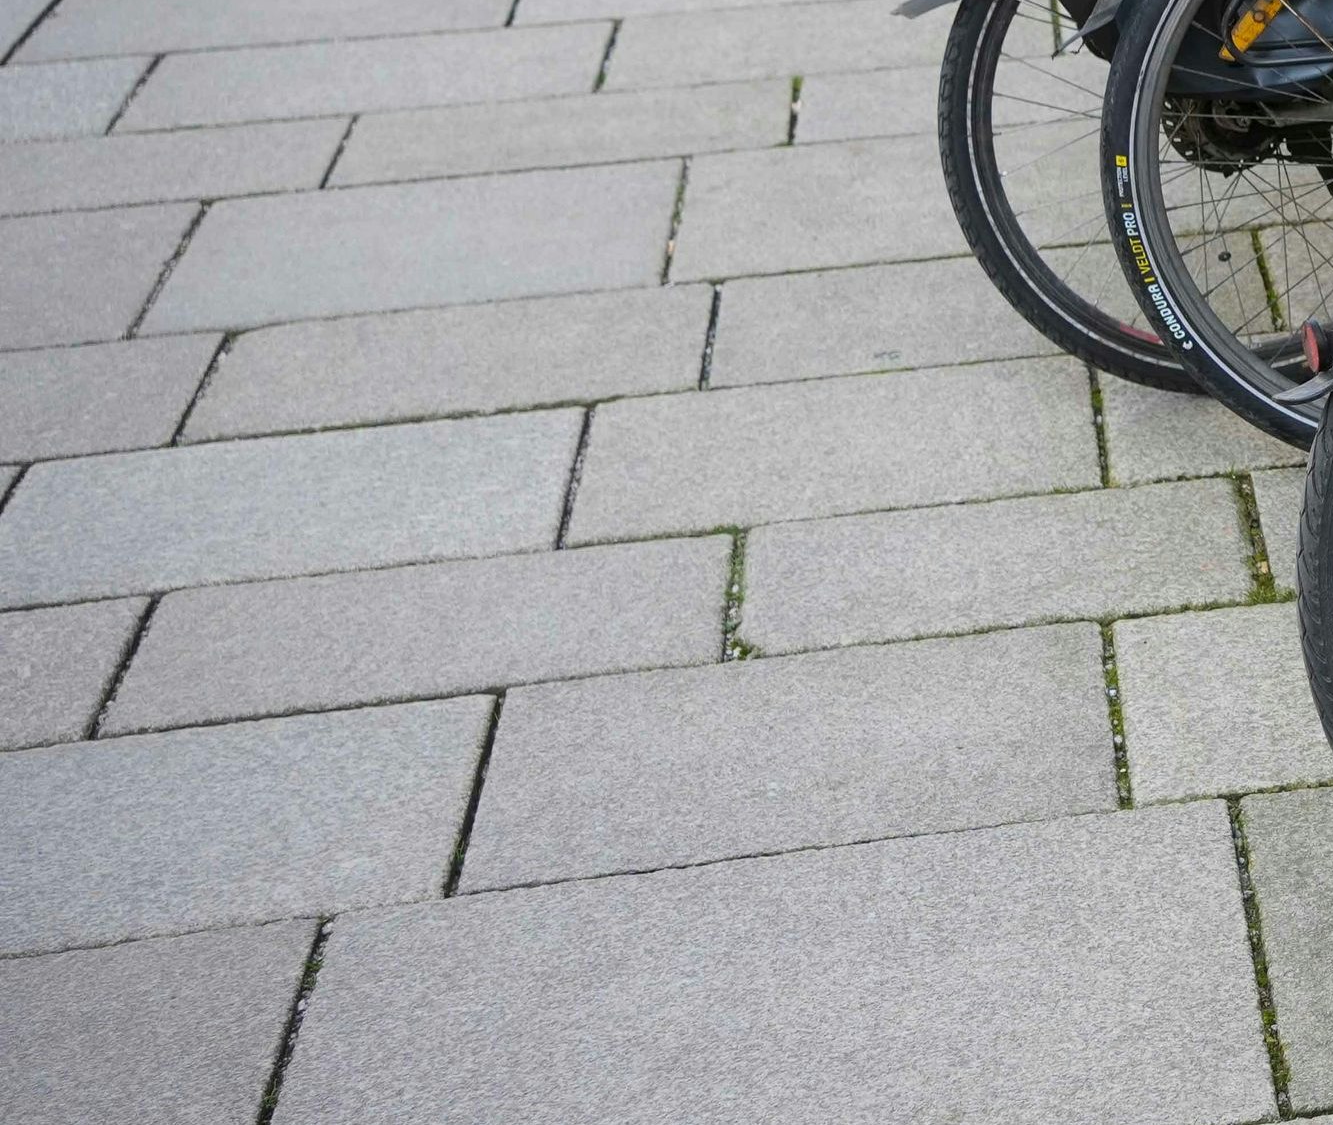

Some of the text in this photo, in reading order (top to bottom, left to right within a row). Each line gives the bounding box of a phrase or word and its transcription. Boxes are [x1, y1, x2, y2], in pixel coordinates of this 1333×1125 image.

[1122, 212, 1186, 339] CONDURA VELDT PRO
